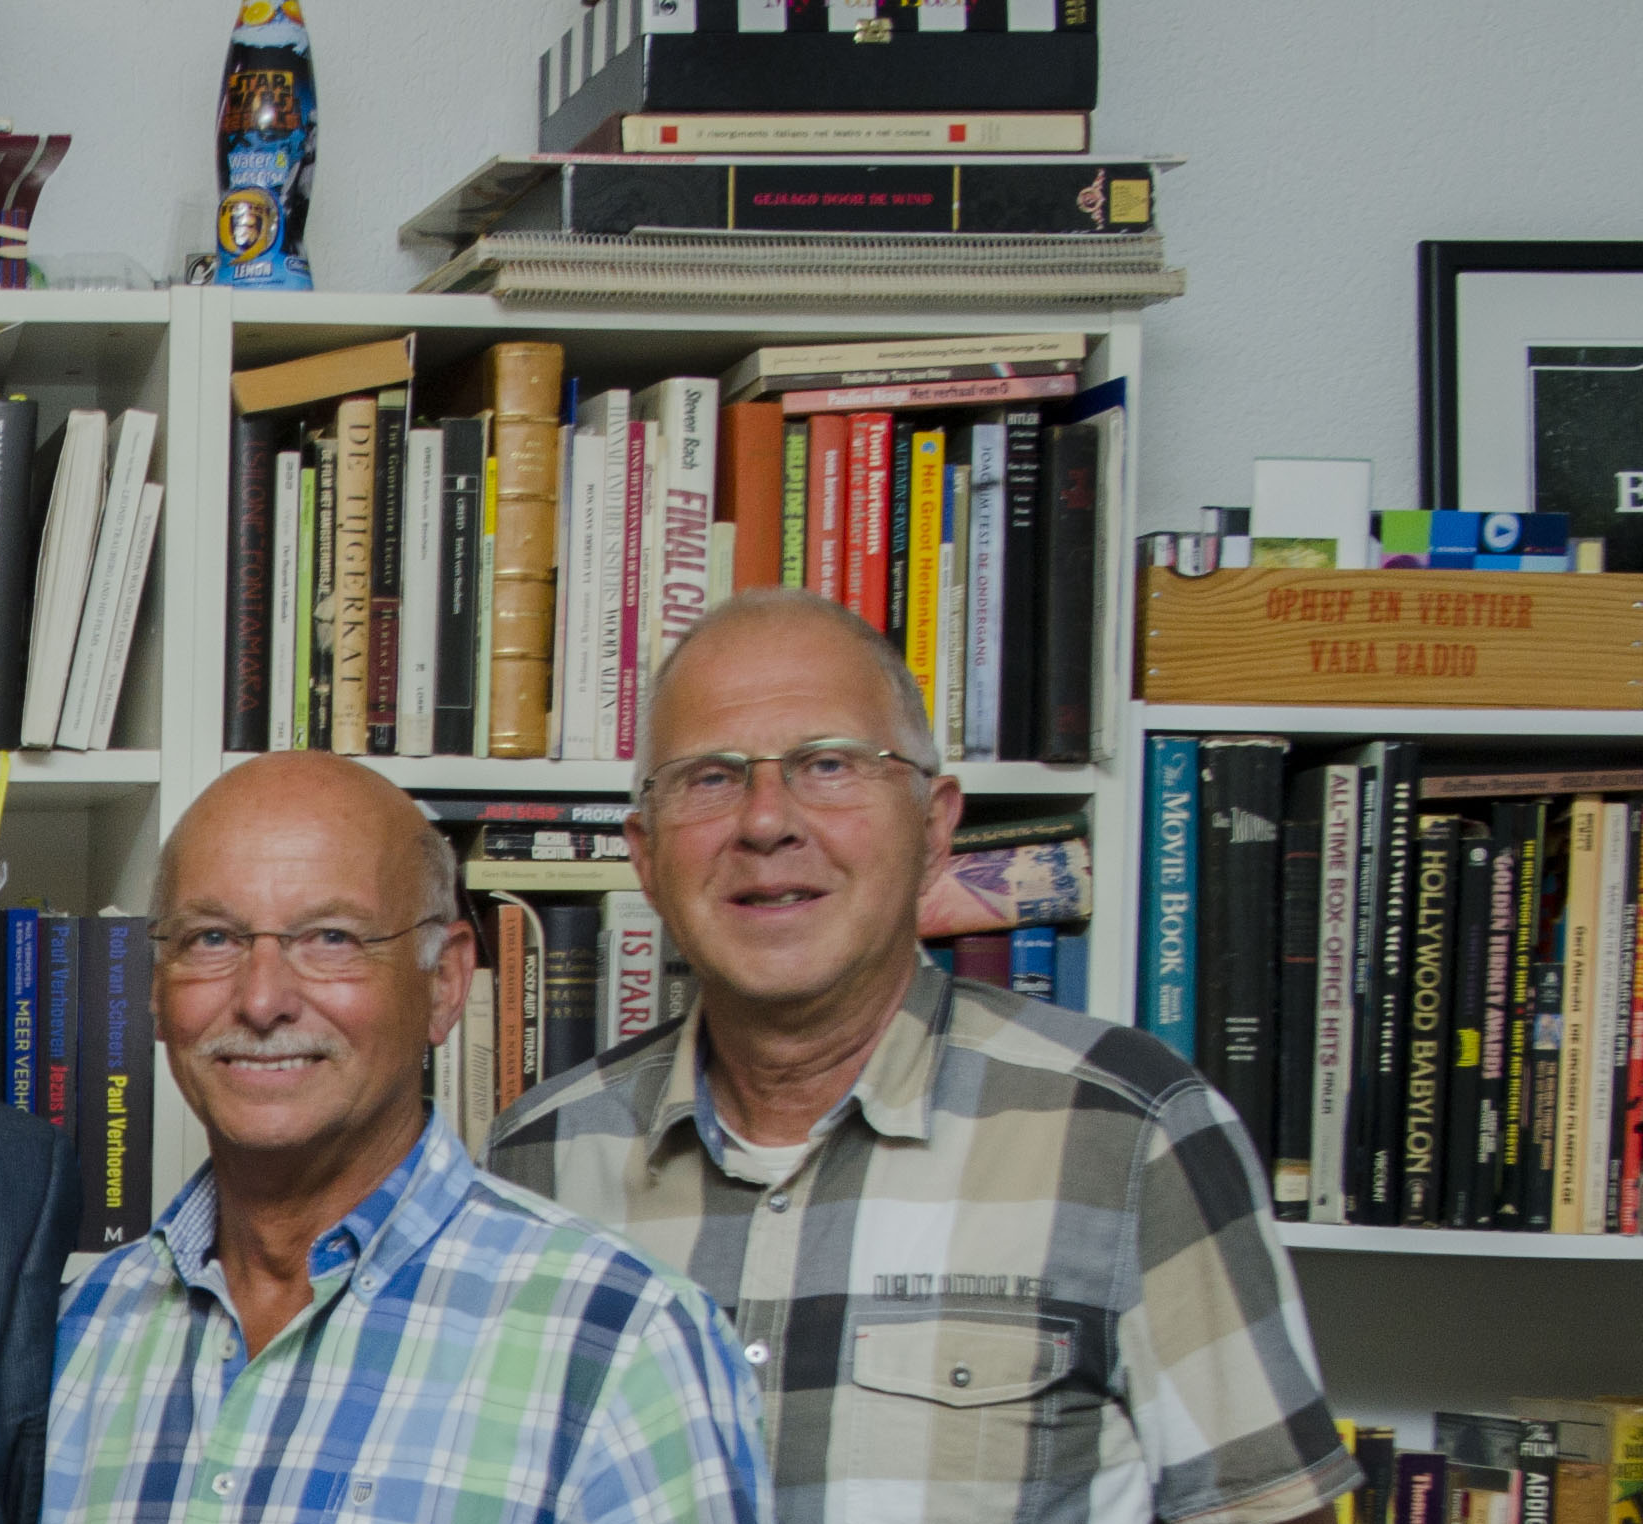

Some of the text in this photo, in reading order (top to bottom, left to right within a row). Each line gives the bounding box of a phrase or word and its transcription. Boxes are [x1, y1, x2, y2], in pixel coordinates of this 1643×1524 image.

[348, 423, 371, 471] DE
[866, 421, 886, 554] Toon Kortooms
[664, 487, 708, 575] FINAL
[914, 463, 935, 668] Het Groot Hertenkamp
[1158, 790, 1190, 978] MOVIE BOOK
[1319, 772, 1350, 1067] ALL-TIME BOX-OFFICE HITS
[1404, 850, 1446, 1174] HOLLYWOOD BABYLON
[105, 1075, 127, 1209] Paul Verhoeven
